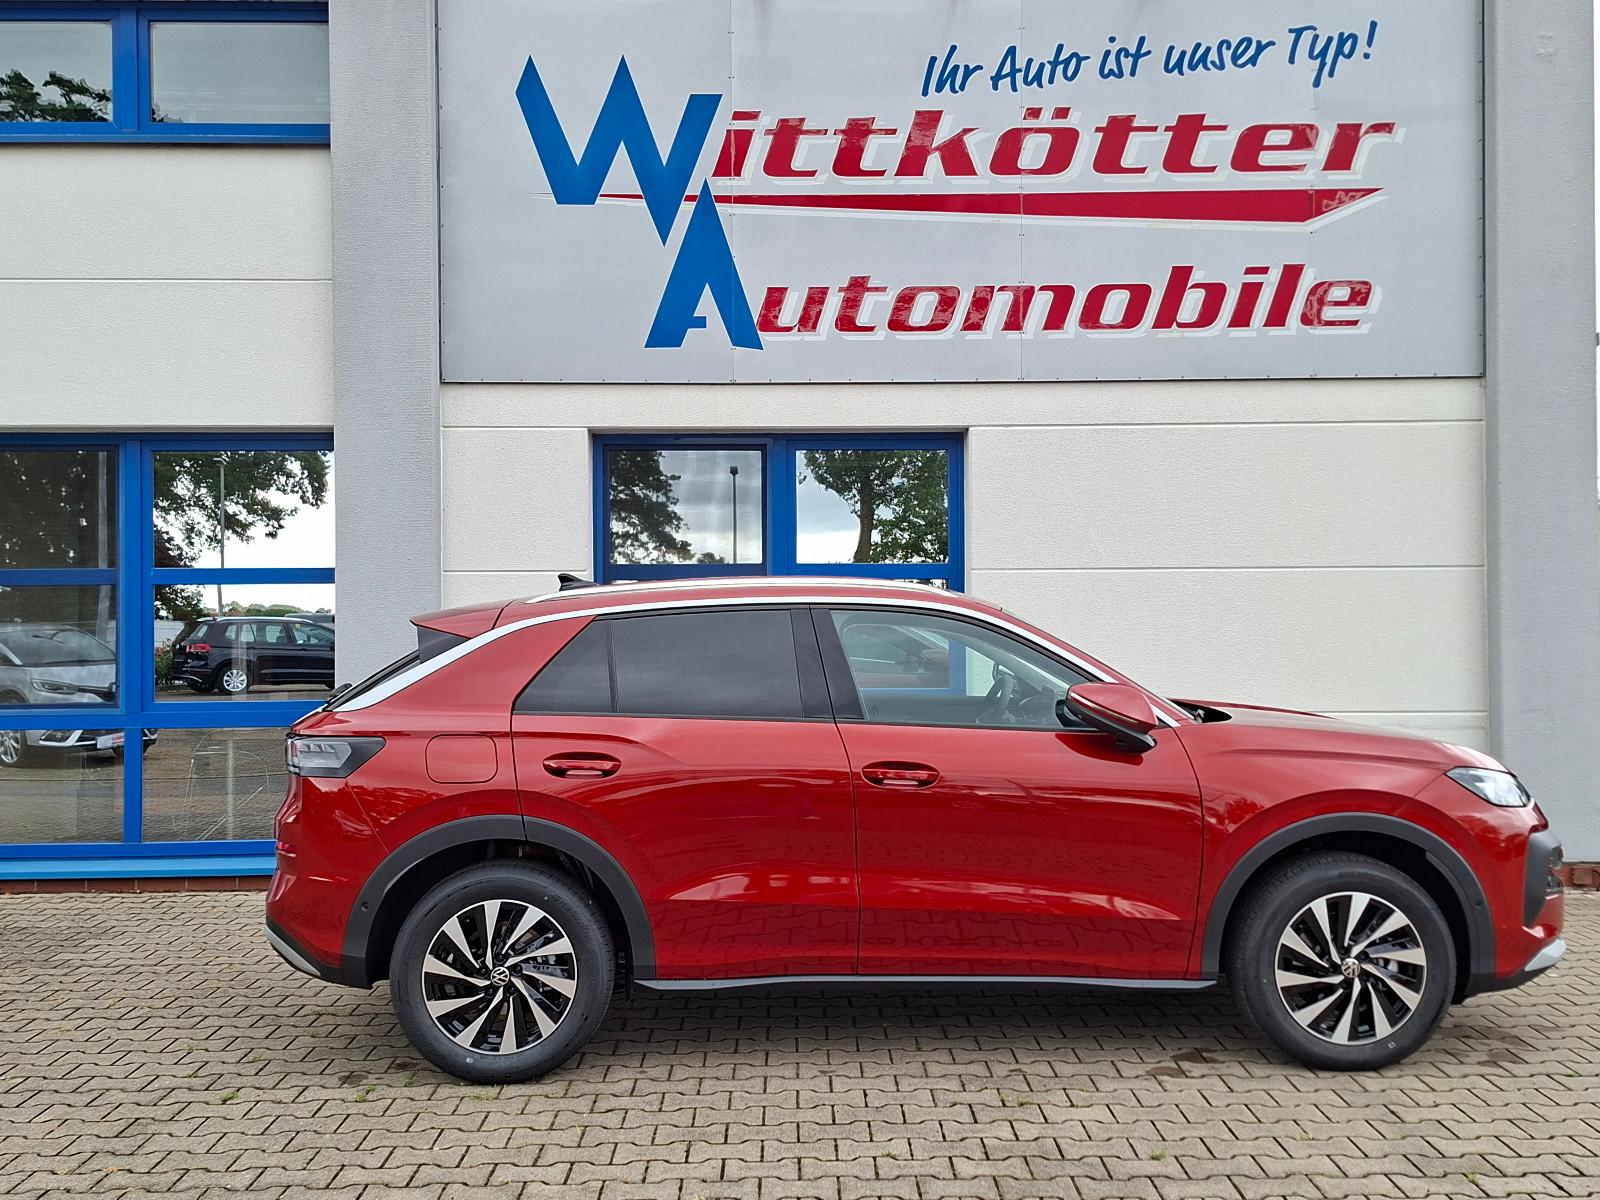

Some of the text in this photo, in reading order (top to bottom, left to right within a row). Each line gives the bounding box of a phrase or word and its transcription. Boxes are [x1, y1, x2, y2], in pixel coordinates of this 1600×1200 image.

[921, 20, 1378, 97] Ihr Auto ist unser Typ!
[515, 54, 1400, 246] Wittkötter
[644, 178, 1378, 351] Automobile
